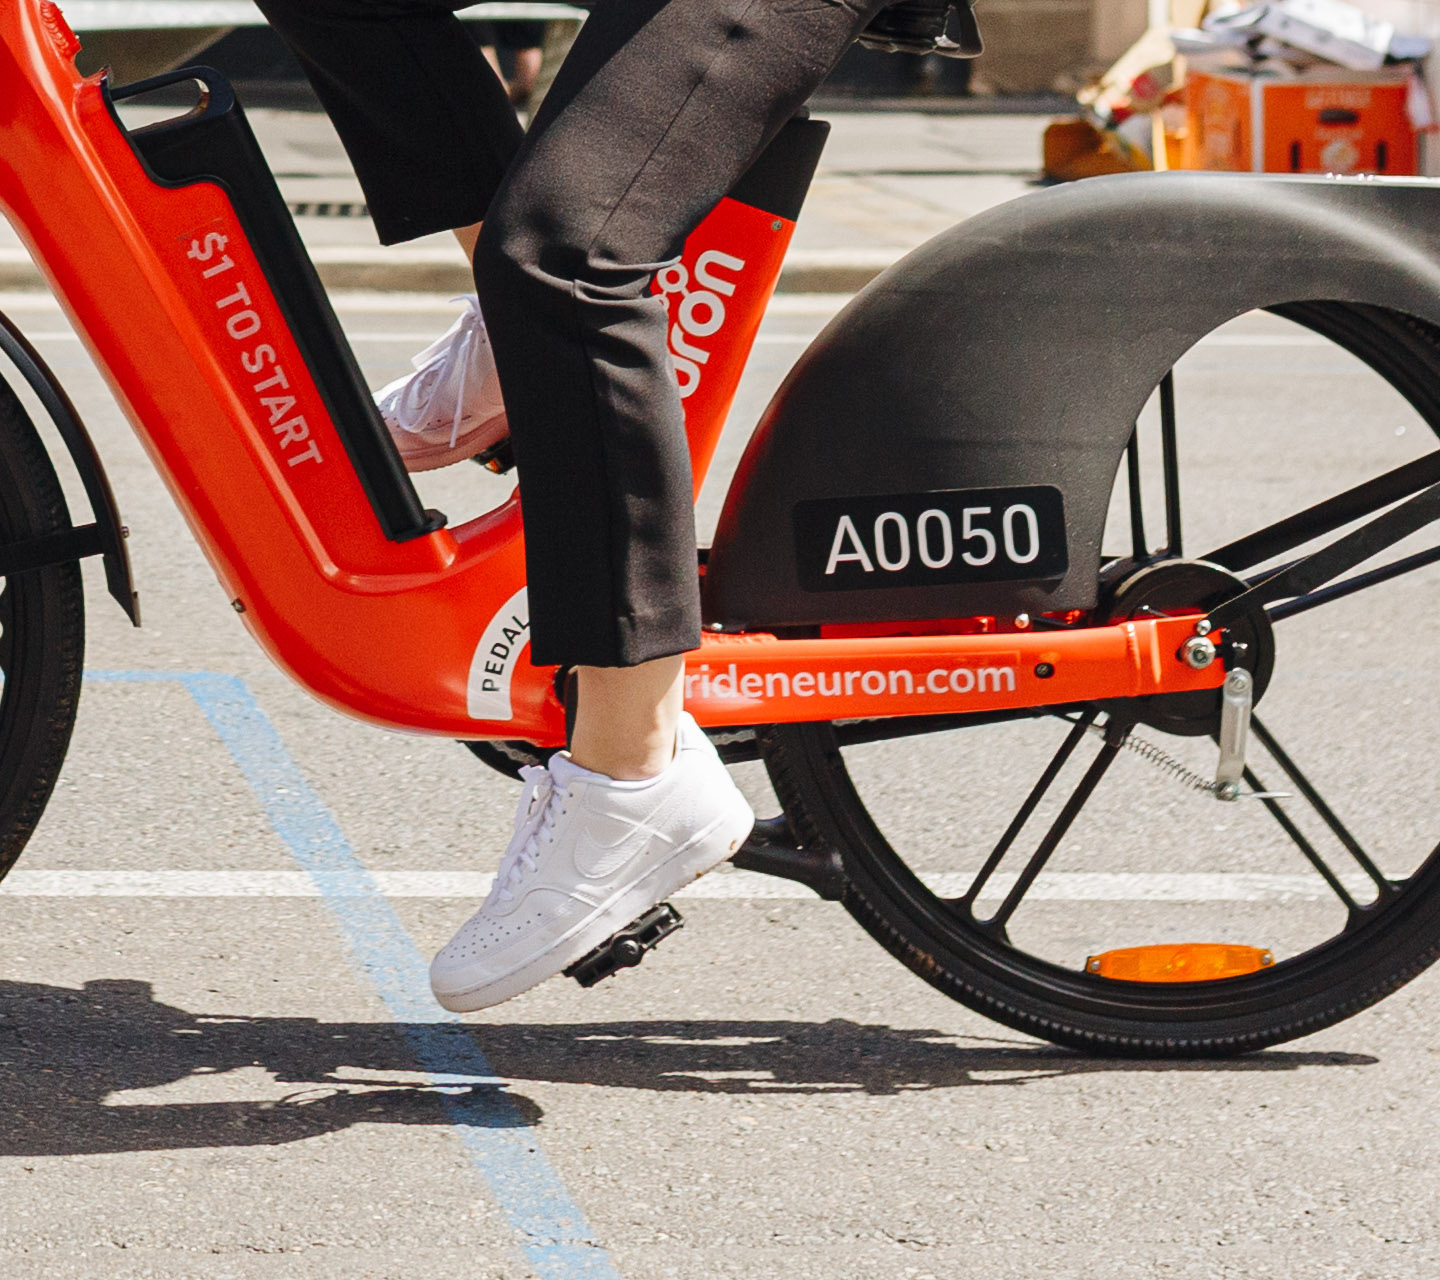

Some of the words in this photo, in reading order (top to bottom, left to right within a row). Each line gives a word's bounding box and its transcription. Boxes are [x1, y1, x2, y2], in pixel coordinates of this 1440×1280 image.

[187, 232, 235, 279] $1
[216, 282, 261, 340] TO
[241, 344, 324, 467] START
[666, 248, 746, 400] uron
[824, 503, 1040, 575] A0050
[481, 615, 531, 692] PEDAL
[684, 663, 1017, 699] rideneuron.com
